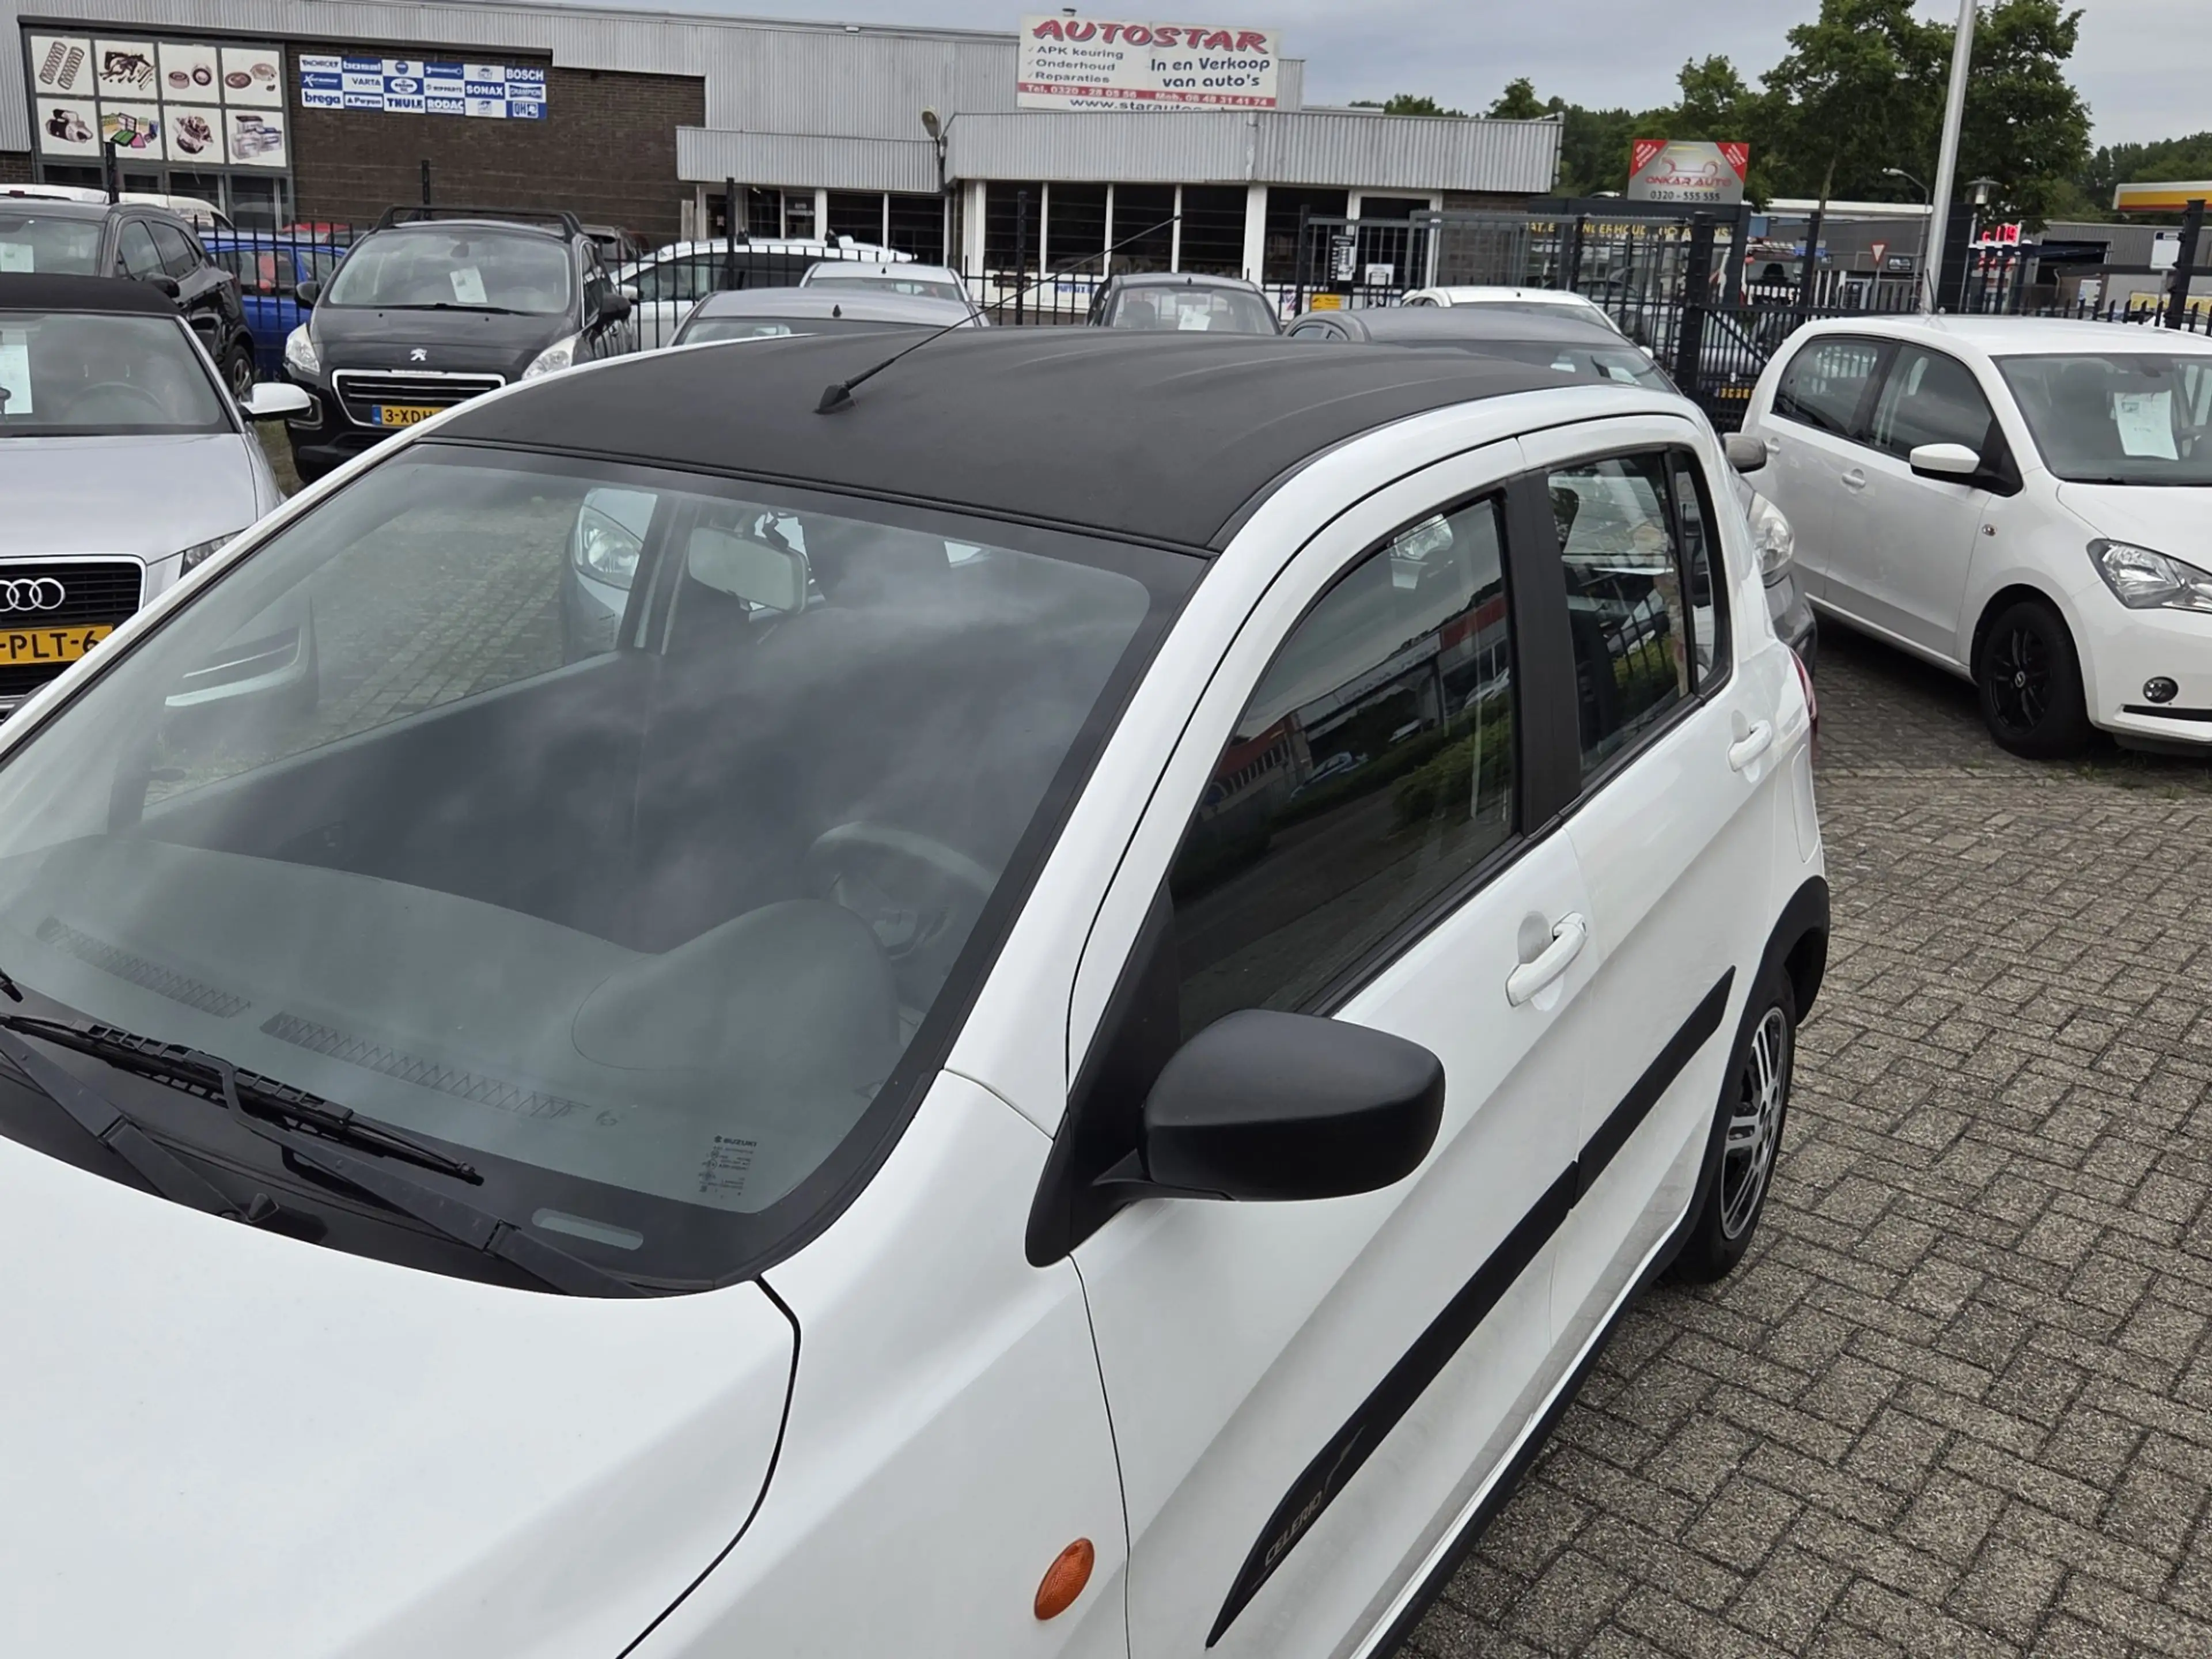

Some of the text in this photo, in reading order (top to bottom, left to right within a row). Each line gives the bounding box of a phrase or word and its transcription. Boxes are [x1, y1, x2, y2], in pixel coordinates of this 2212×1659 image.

[1032, 19, 1269, 54] AUTOSTAR
[1037, 46, 1124, 60] APK keuring
[1036, 59, 1116, 71] Onderhoud
[1151, 57, 1270, 72] In en Verkoop
[506, 69, 544, 81] BOSCH
[1035, 71, 1110, 84] Reparaties
[1162, 74, 1260, 87] van auto's
[352, 77, 381, 86] VARTA
[466, 85, 503, 95] SONAX
[1026, 84, 1047, 93] Tel.
[305, 91, 340, 105] brega
[387, 98, 423, 108] THULE
[427, 99, 464, 109] RODAC
[1695, 177, 1732, 188] AUTO
[1650, 190, 1674, 200] 0320
[1683, 191, 1700, 200] 555
[1703, 192, 1720, 201] 555
[1265, 1490, 1323, 1567] CELERIO
